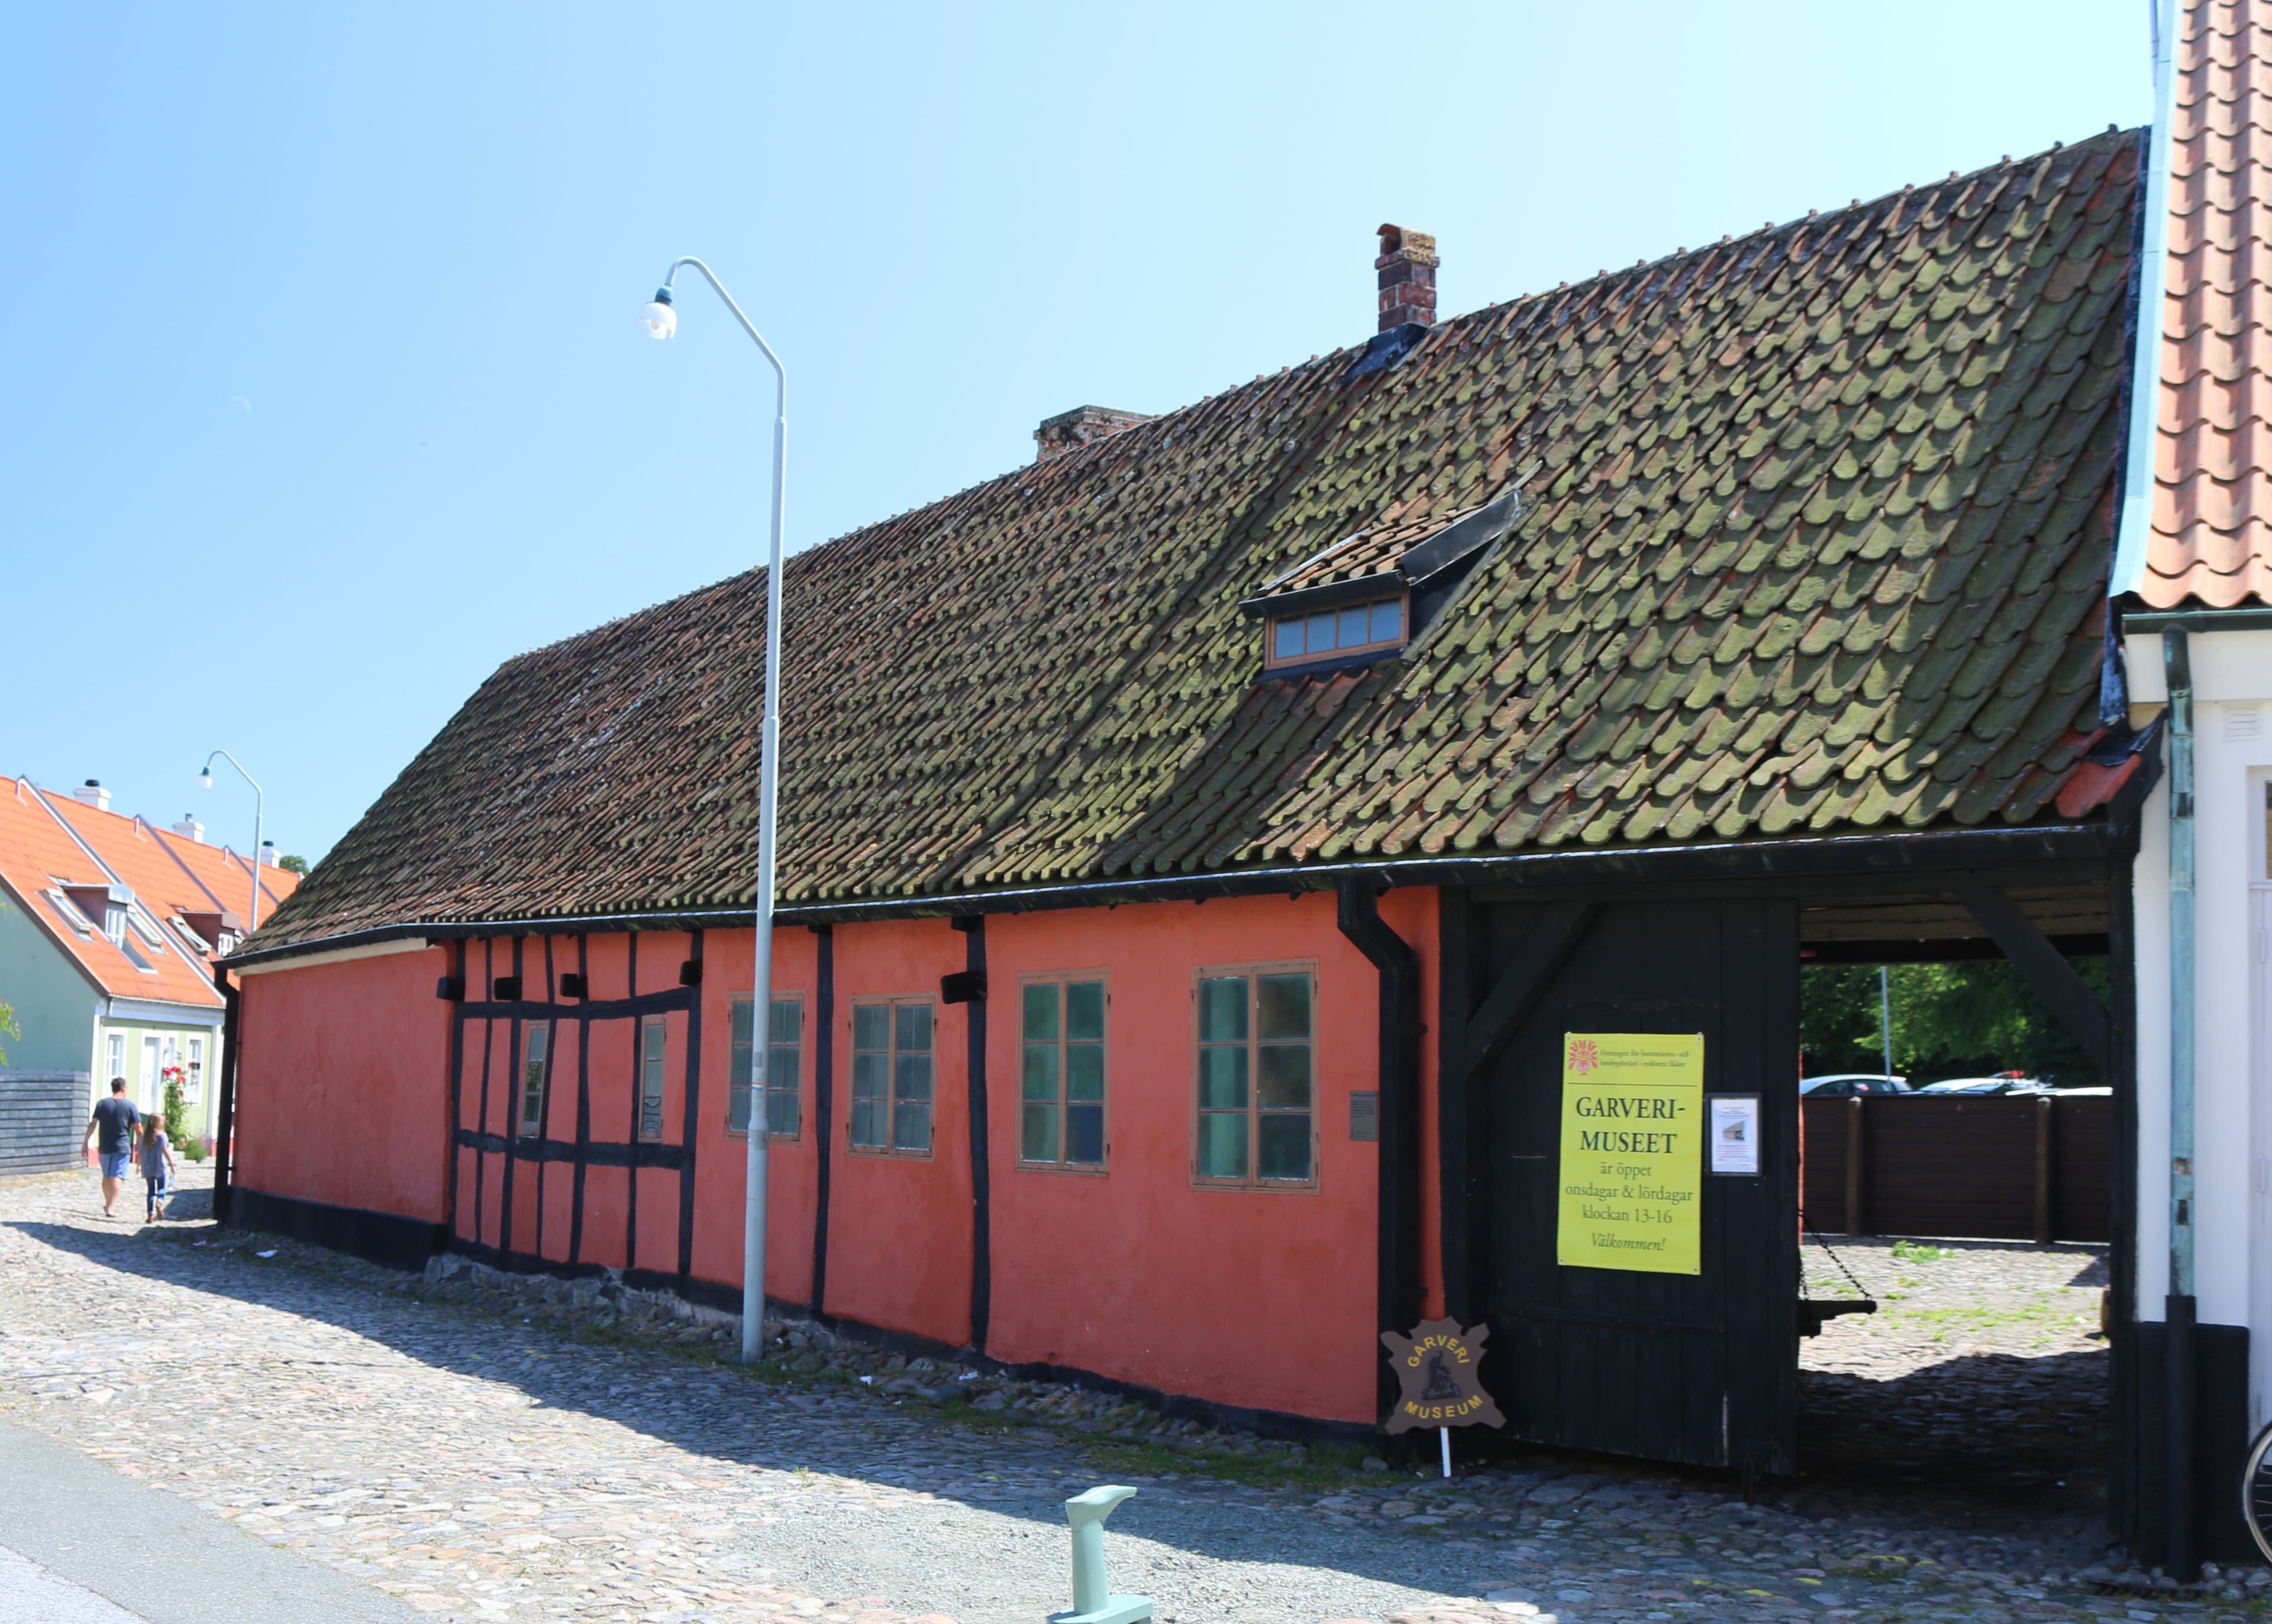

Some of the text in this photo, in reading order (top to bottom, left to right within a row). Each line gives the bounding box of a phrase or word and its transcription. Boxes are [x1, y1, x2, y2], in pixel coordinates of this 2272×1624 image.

[1576, 1097, 1686, 1119] GARVERI-
[1580, 1131, 1677, 1154] MUSEET
[1600, 1161, 1652, 1180] är öppet
[1566, 1182, 1693, 1205] onsdagar & lördagar
[1583, 1205, 1673, 1223] klockan 13-16
[1592, 1232, 1666, 1251] Välkommen!
[1407, 1335, 1470, 1367] GARVERI
[1404, 1394, 1483, 1419] MUSEUM
